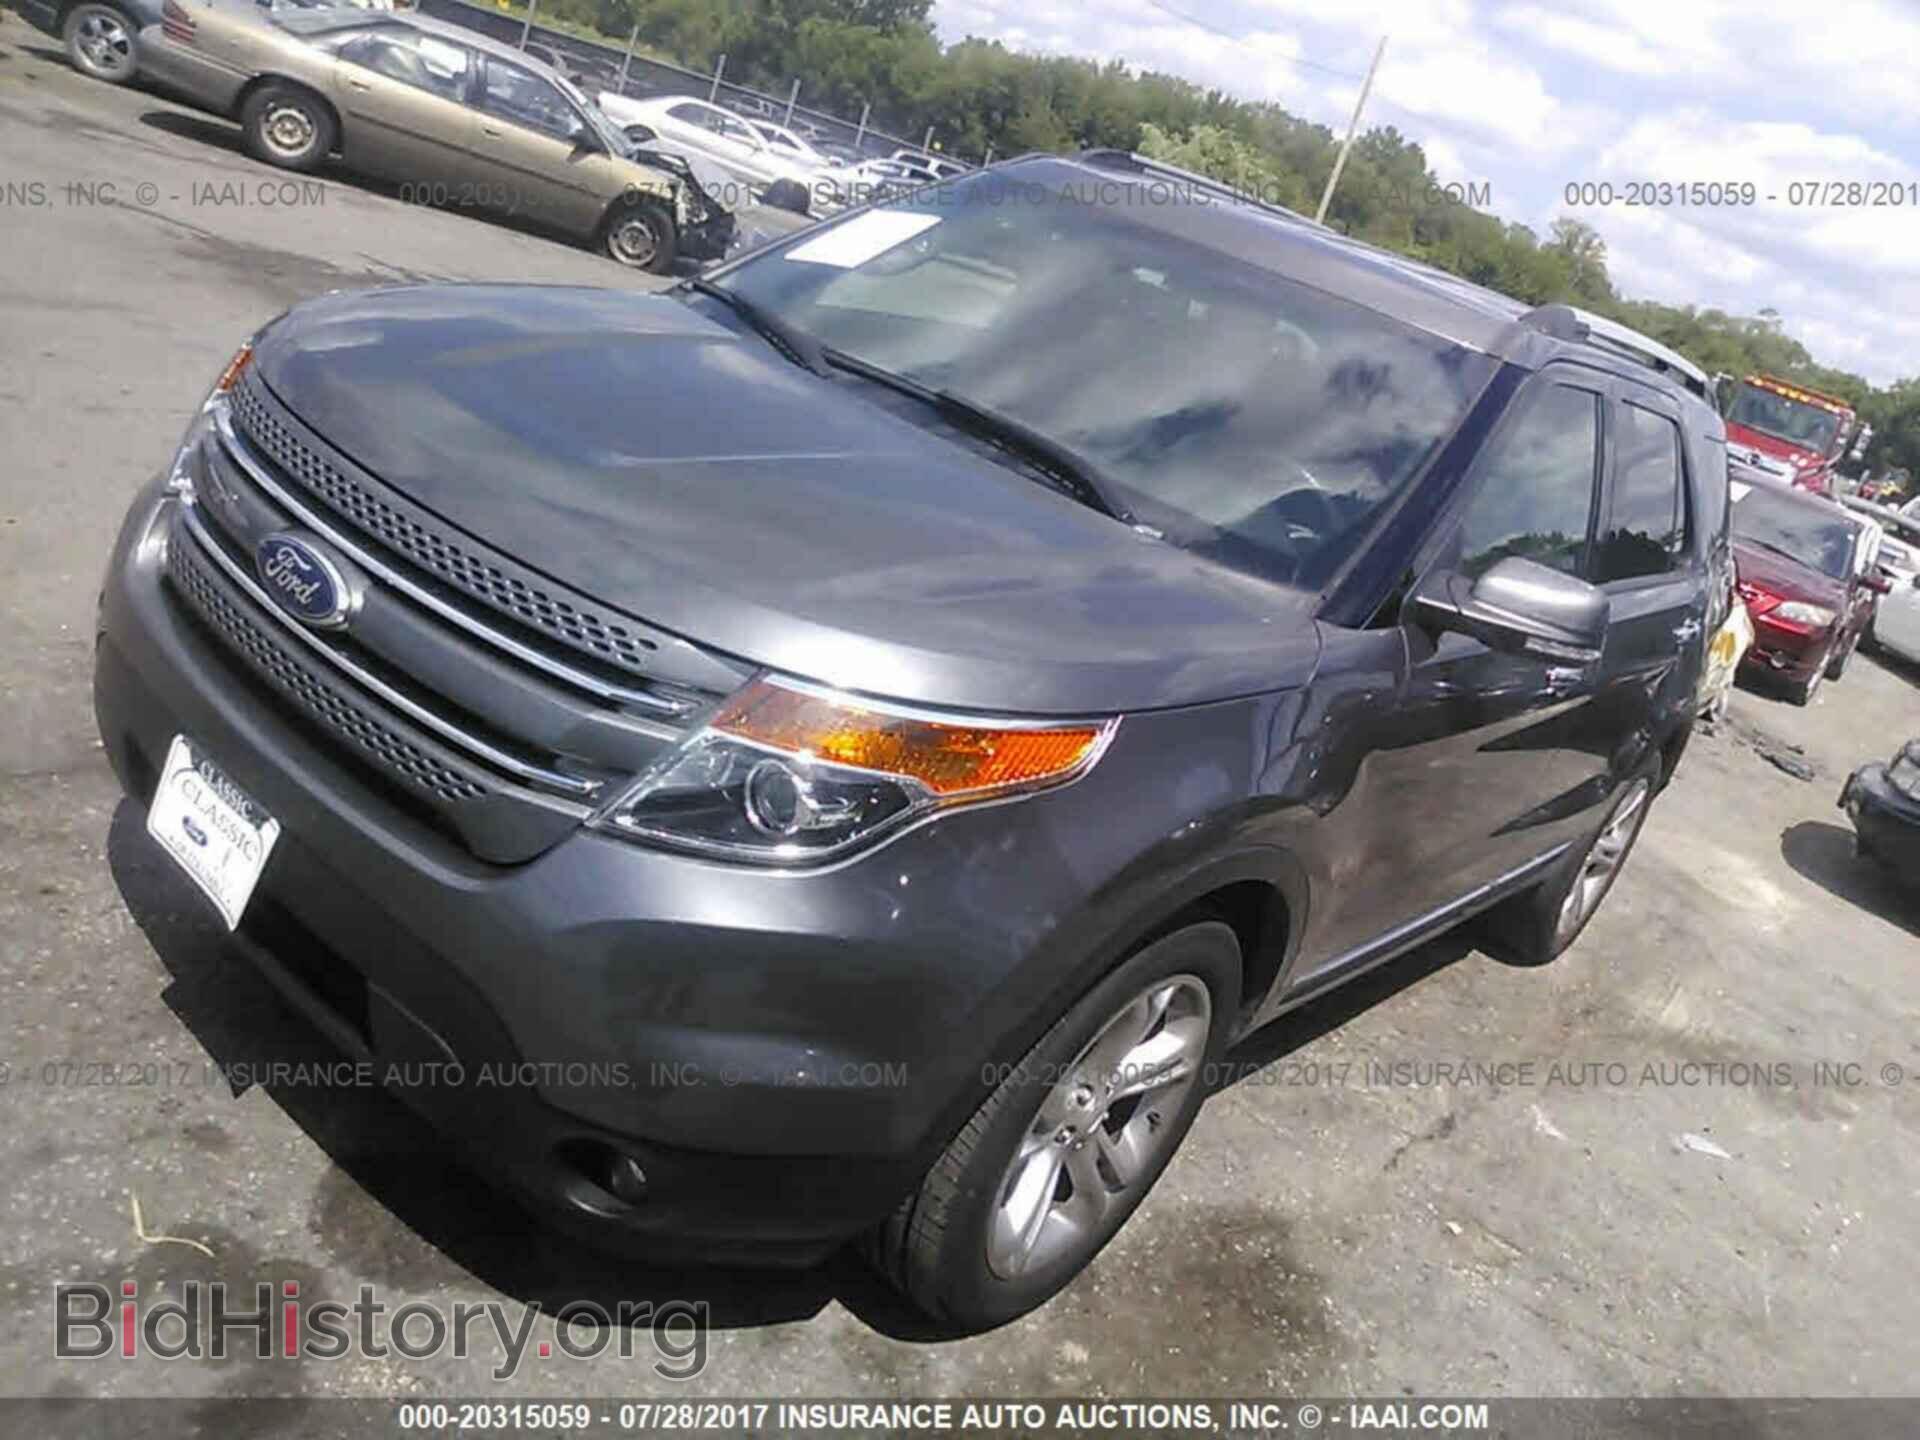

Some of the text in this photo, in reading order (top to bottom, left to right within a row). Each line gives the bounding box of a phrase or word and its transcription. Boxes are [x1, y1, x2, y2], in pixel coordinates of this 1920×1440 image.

[264, 546, 321, 605] Ford
[200, 760, 254, 817] CLASSIC
[181, 778, 259, 861] CLASSIC
